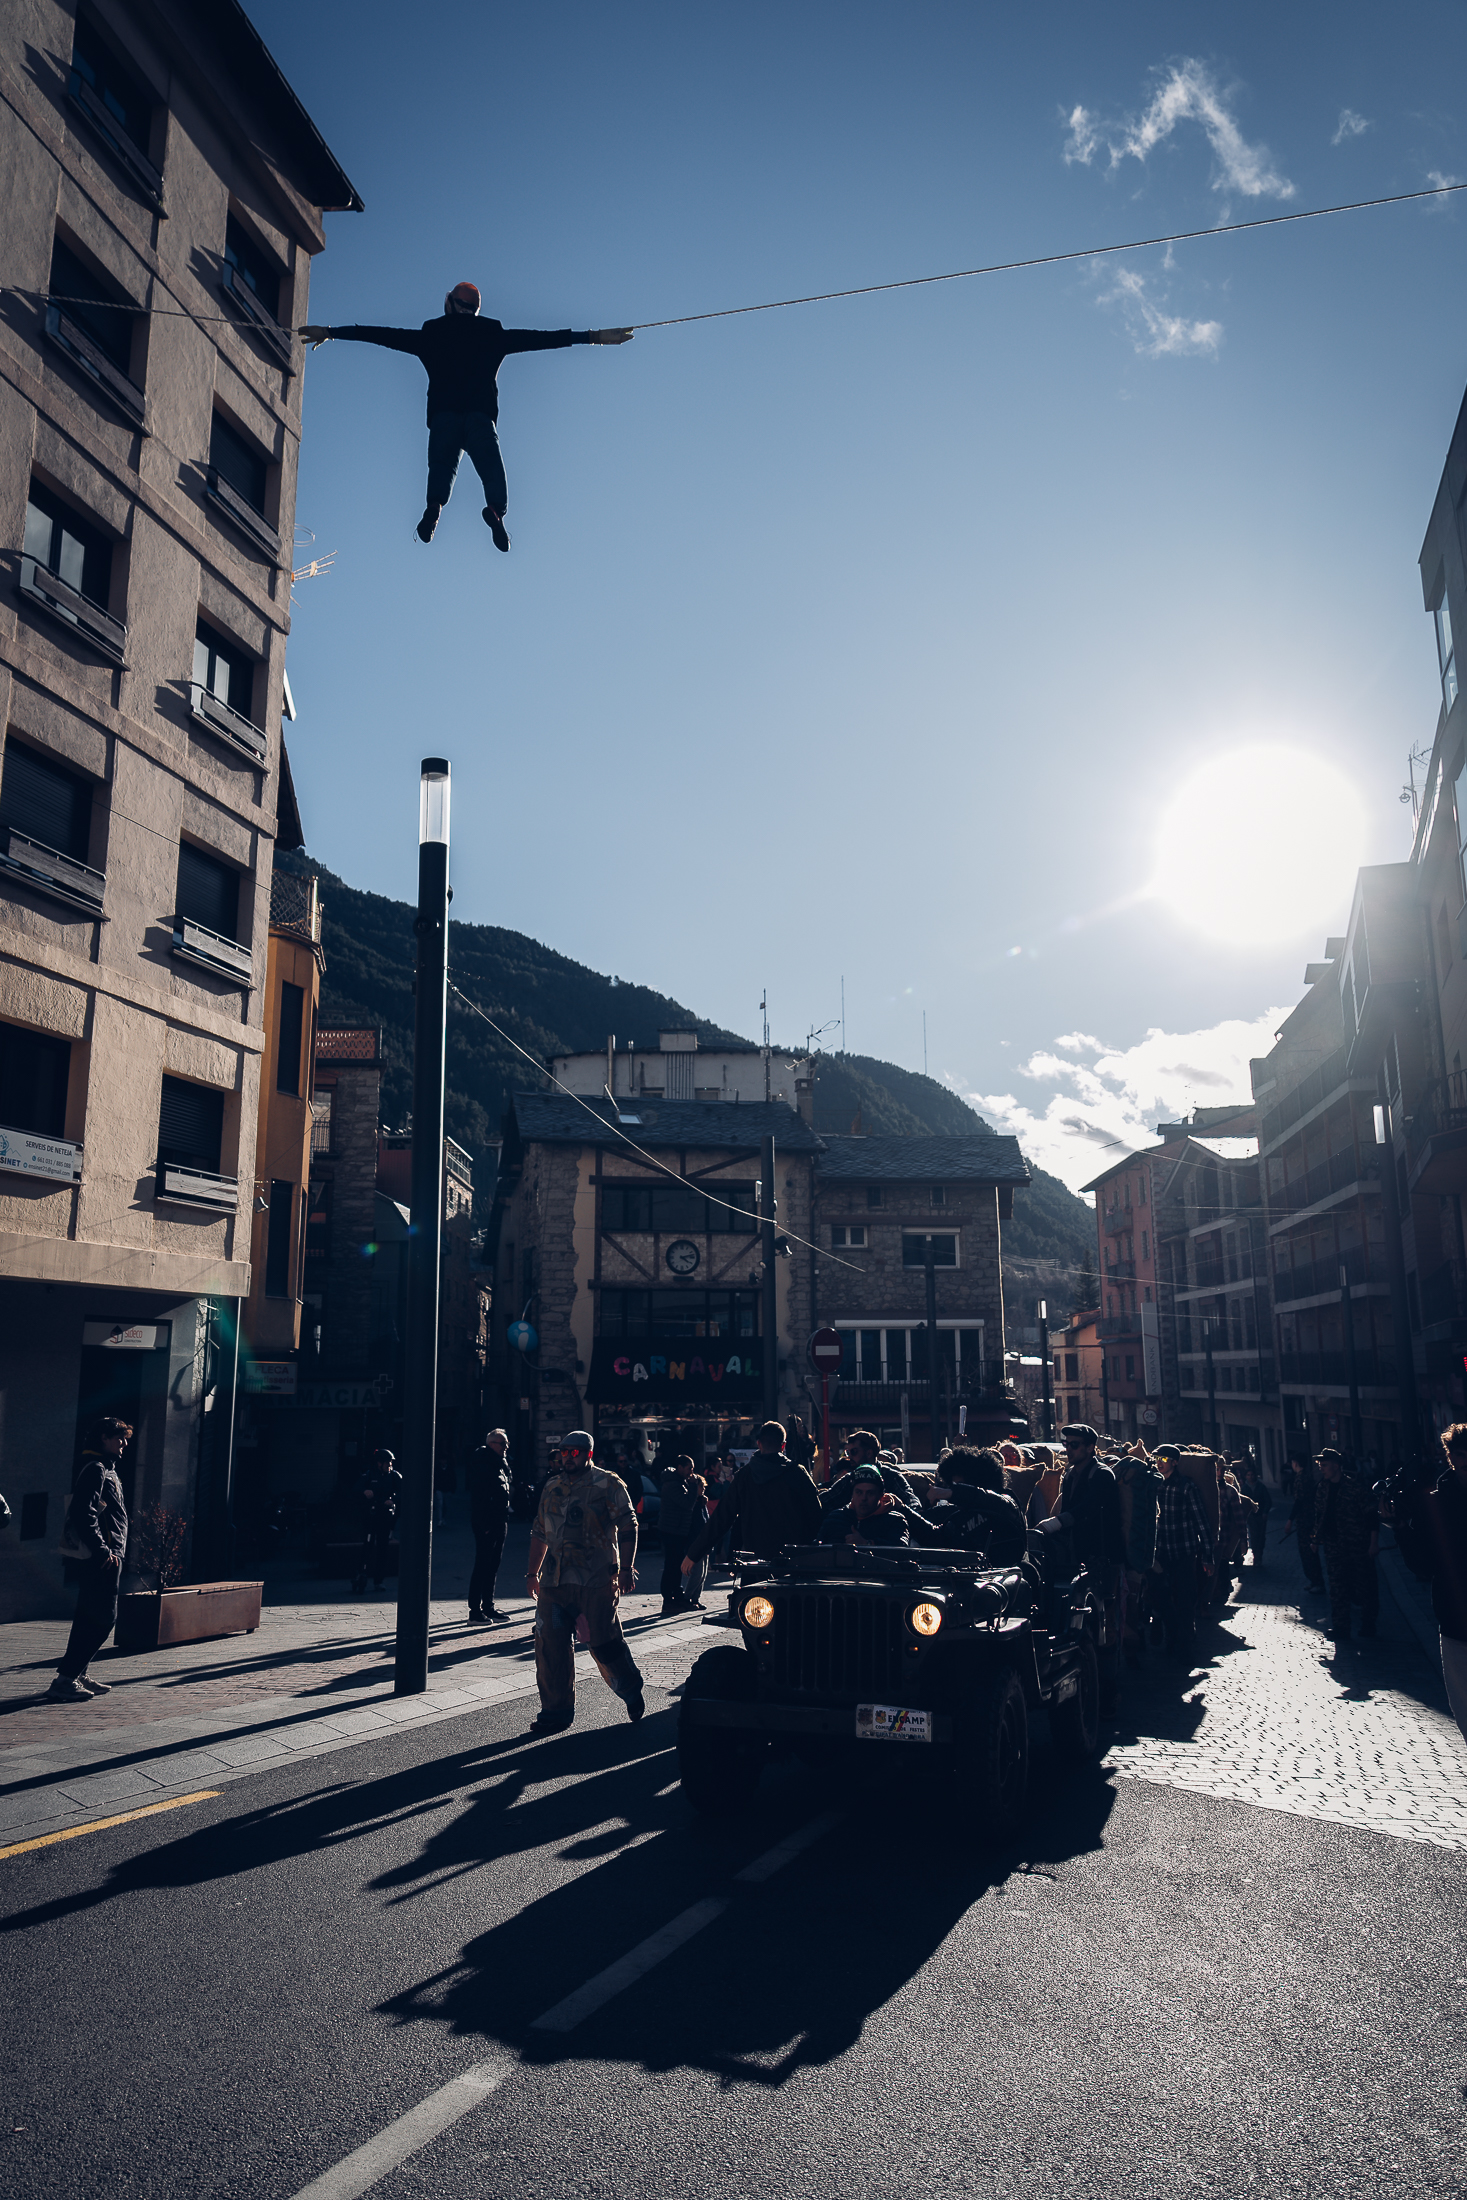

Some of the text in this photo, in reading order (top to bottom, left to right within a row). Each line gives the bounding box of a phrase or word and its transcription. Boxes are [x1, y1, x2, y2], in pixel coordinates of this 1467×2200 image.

[25, 1140, 46, 1151] SERVEIS
[54, 1147, 73, 1157] NETEJA
[255, 1365, 290, 1375] FLECA
[613, 1355, 761, 1382] CARNAVAL
[1148, 1346, 1158, 1394] ANDBANK
[888, 1714, 925, 1725] ENCAMP
